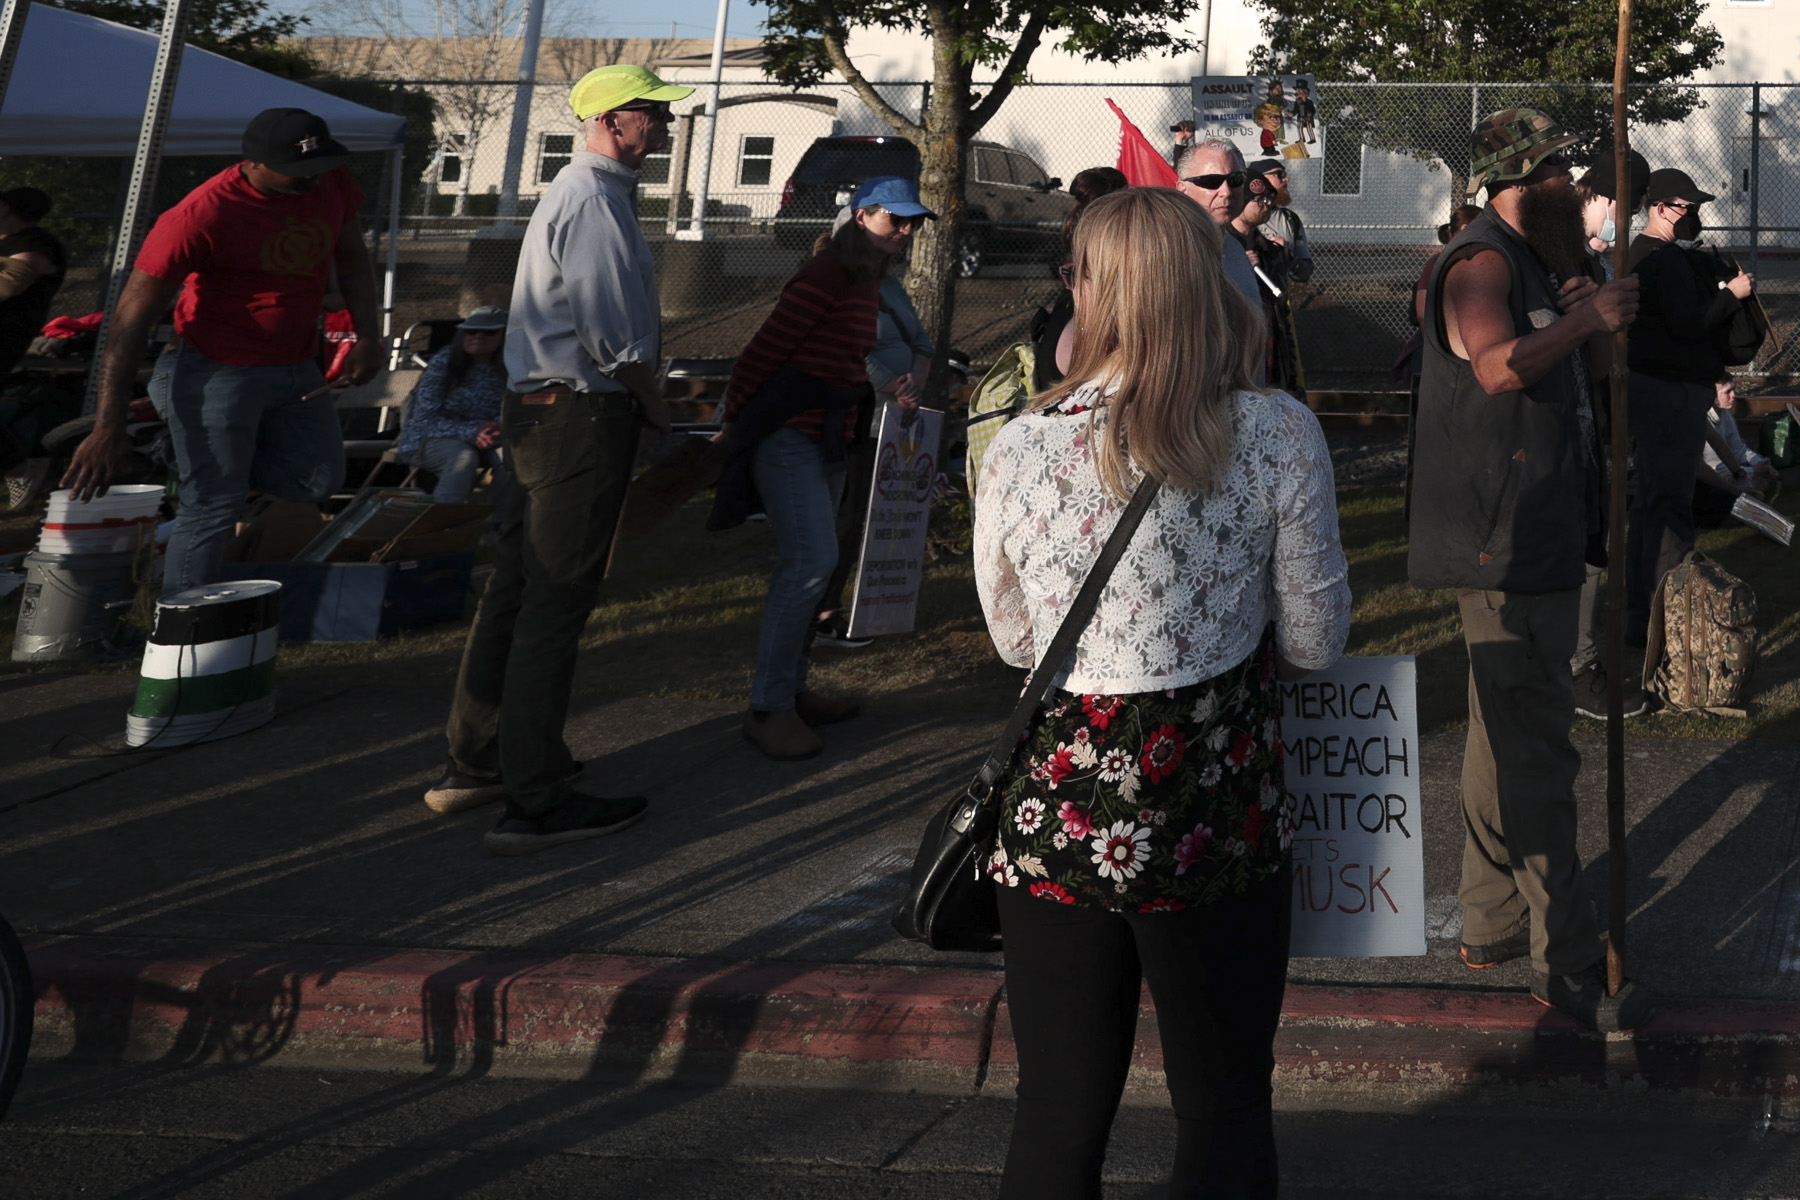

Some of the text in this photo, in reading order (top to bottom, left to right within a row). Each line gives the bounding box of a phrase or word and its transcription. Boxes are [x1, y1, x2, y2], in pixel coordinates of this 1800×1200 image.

[1202, 83, 1254, 95] ASSAULT
[1220, 113, 1243, 121] ASSAULT
[1205, 127, 1253, 139] ALL OF US
[1279, 682, 1398, 721] MERICA
[1283, 735, 1409, 777] MPEACH
[1287, 793, 1411, 838] RAITOR
[1291, 838, 1339, 862] ET'S
